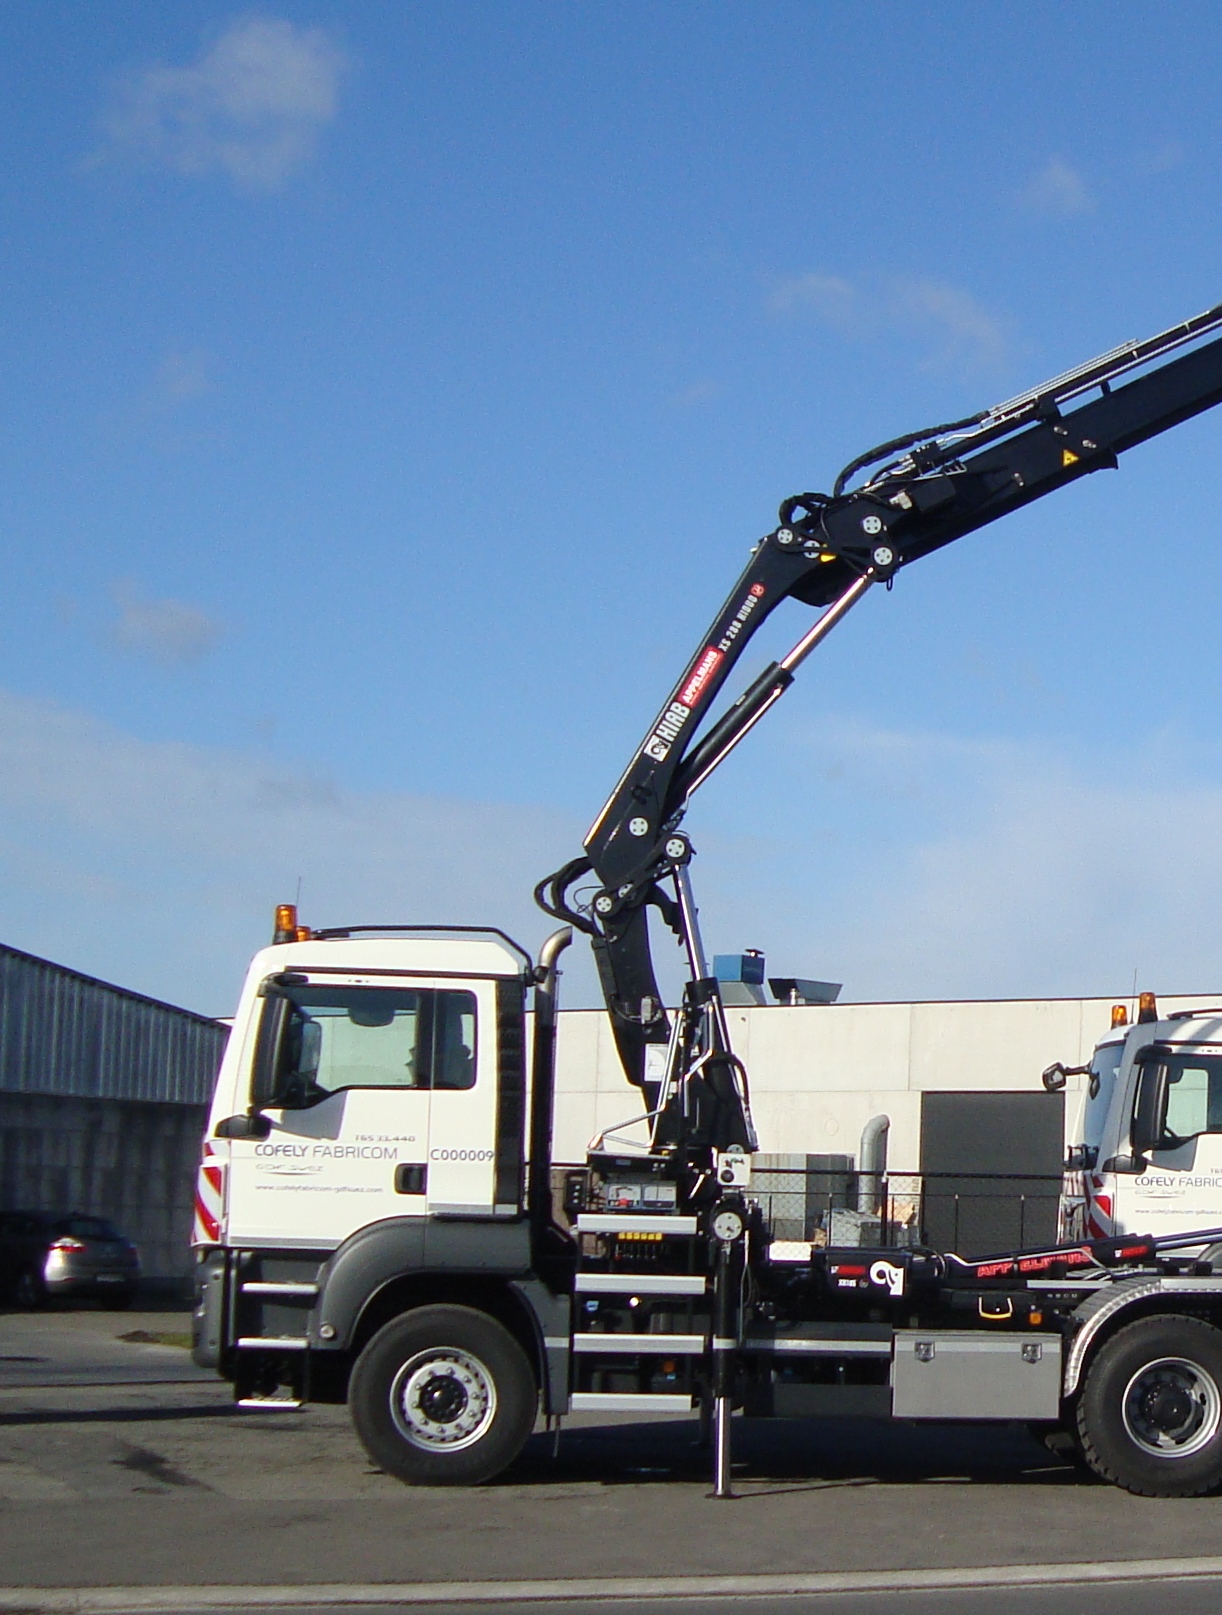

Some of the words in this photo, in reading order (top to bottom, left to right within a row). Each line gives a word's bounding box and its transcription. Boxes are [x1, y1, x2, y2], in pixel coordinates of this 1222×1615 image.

[682, 650, 718, 704] APPELMANS
[656, 701, 691, 742] HIAB
[254, 1144, 308, 1157] COFELY
[313, 1145, 398, 1159] FABRICOM
[430, 1149, 494, 1161] C000009
[1135, 1176, 1176, 1187] COFELY
[977, 1246, 1092, 1278] APPELNS
